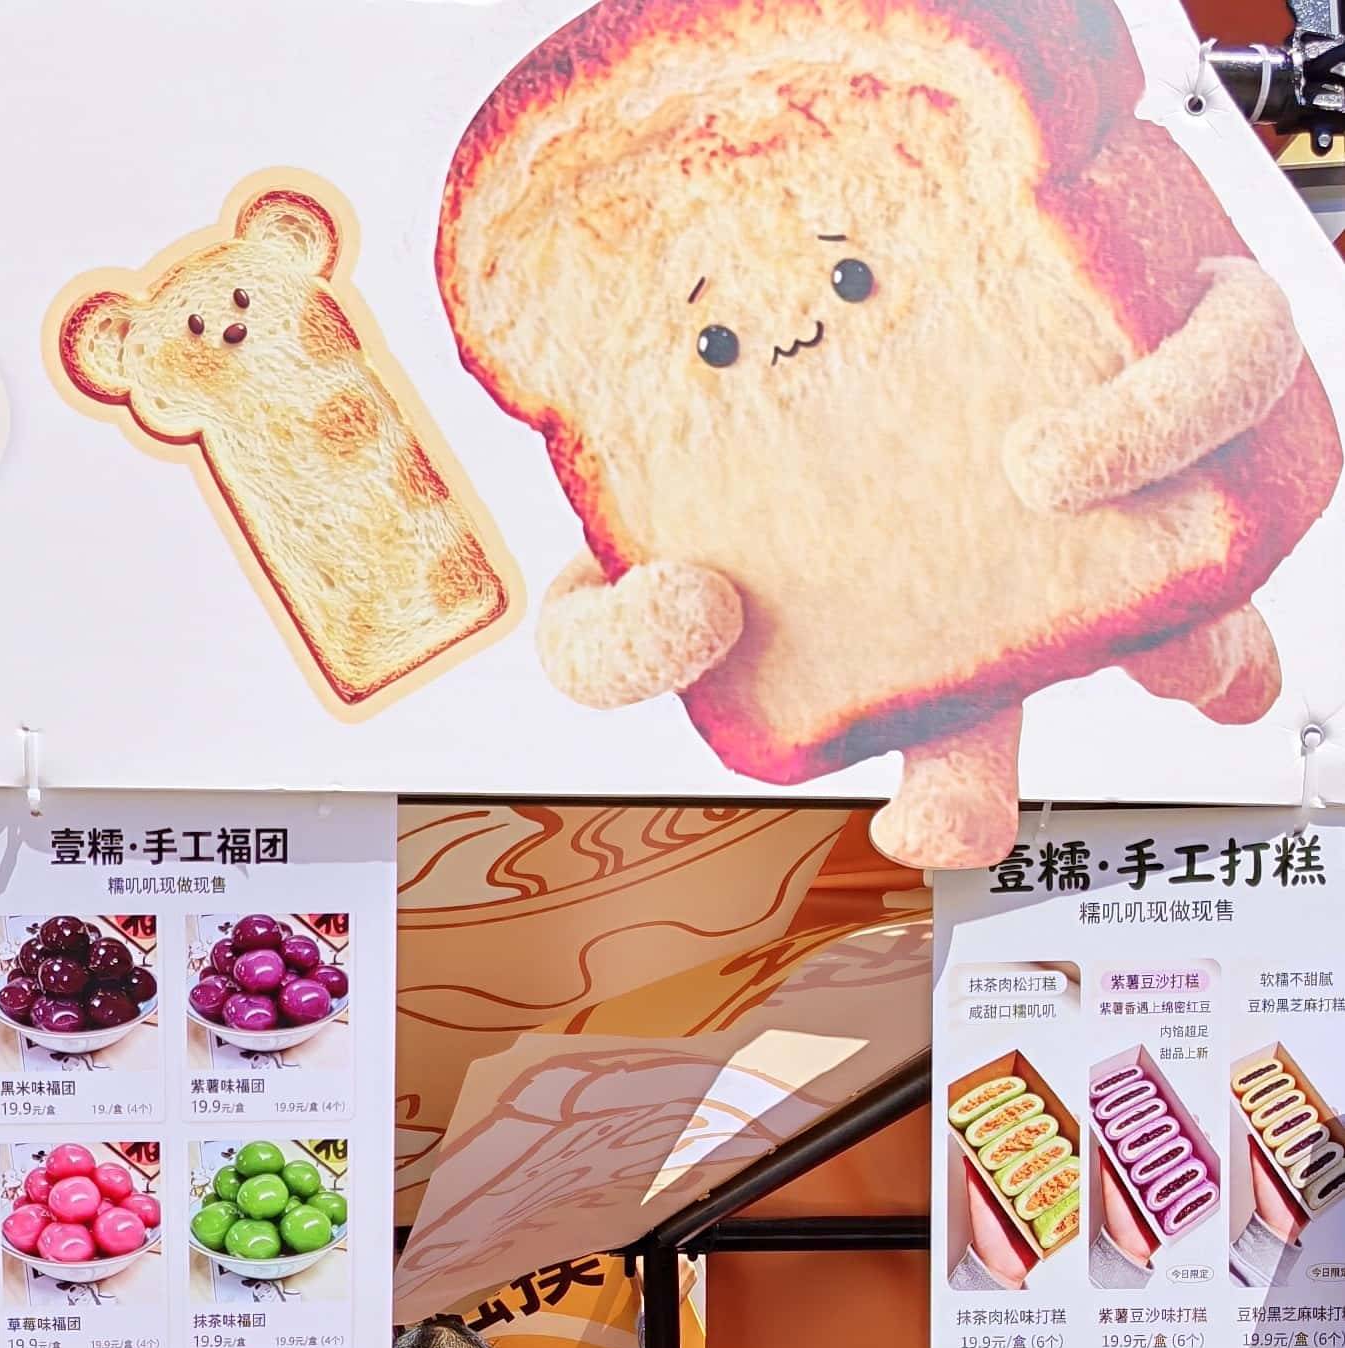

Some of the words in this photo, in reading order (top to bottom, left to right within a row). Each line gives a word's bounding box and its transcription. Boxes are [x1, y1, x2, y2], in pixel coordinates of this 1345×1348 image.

[51, 828, 289, 866] 壹糯·手工福团
[988, 835, 1326, 893] 壹糯·手工打糕
[108, 876, 226, 895] 糯叽叽现做现售
[1079, 899, 1234, 924] 糯叽叽现做现售
[968, 976, 1058, 993] 抹茶肉松打糕
[1110, 973, 1200, 990] 紫薯豆沙打糕
[1260, 971, 1333, 987] 软糯不甜腻
[968, 1004, 1056, 1019] 咸甜口糯叽叽
[1160, 1025, 1209, 1038] 内馅超足
[1160, 1047, 1209, 1060] 甜品上新
[0, 1080, 76, 1096] 黑米味福团
[190, 1078, 265, 1095] 紫薯味福团
[1, 1101, 56, 1116] 19.9元/盒
[191, 1099, 246, 1114] 19.9元/盒
[1171, 1269, 1209, 1281] 今日限定
[193, 1312, 267, 1329] 抹茶味福团
[956, 1308, 1067, 1325] 抹茶肉松味打糕
[1098, 1307, 1207, 1324] 紫薯豆沙味打糕
[1237, 1305, 1345, 1322] 豆粉黑芝麻味打
[6, 1316, 81, 1332] 草莓味福团
[193, 1333, 246, 1348] 19.9元/盒
